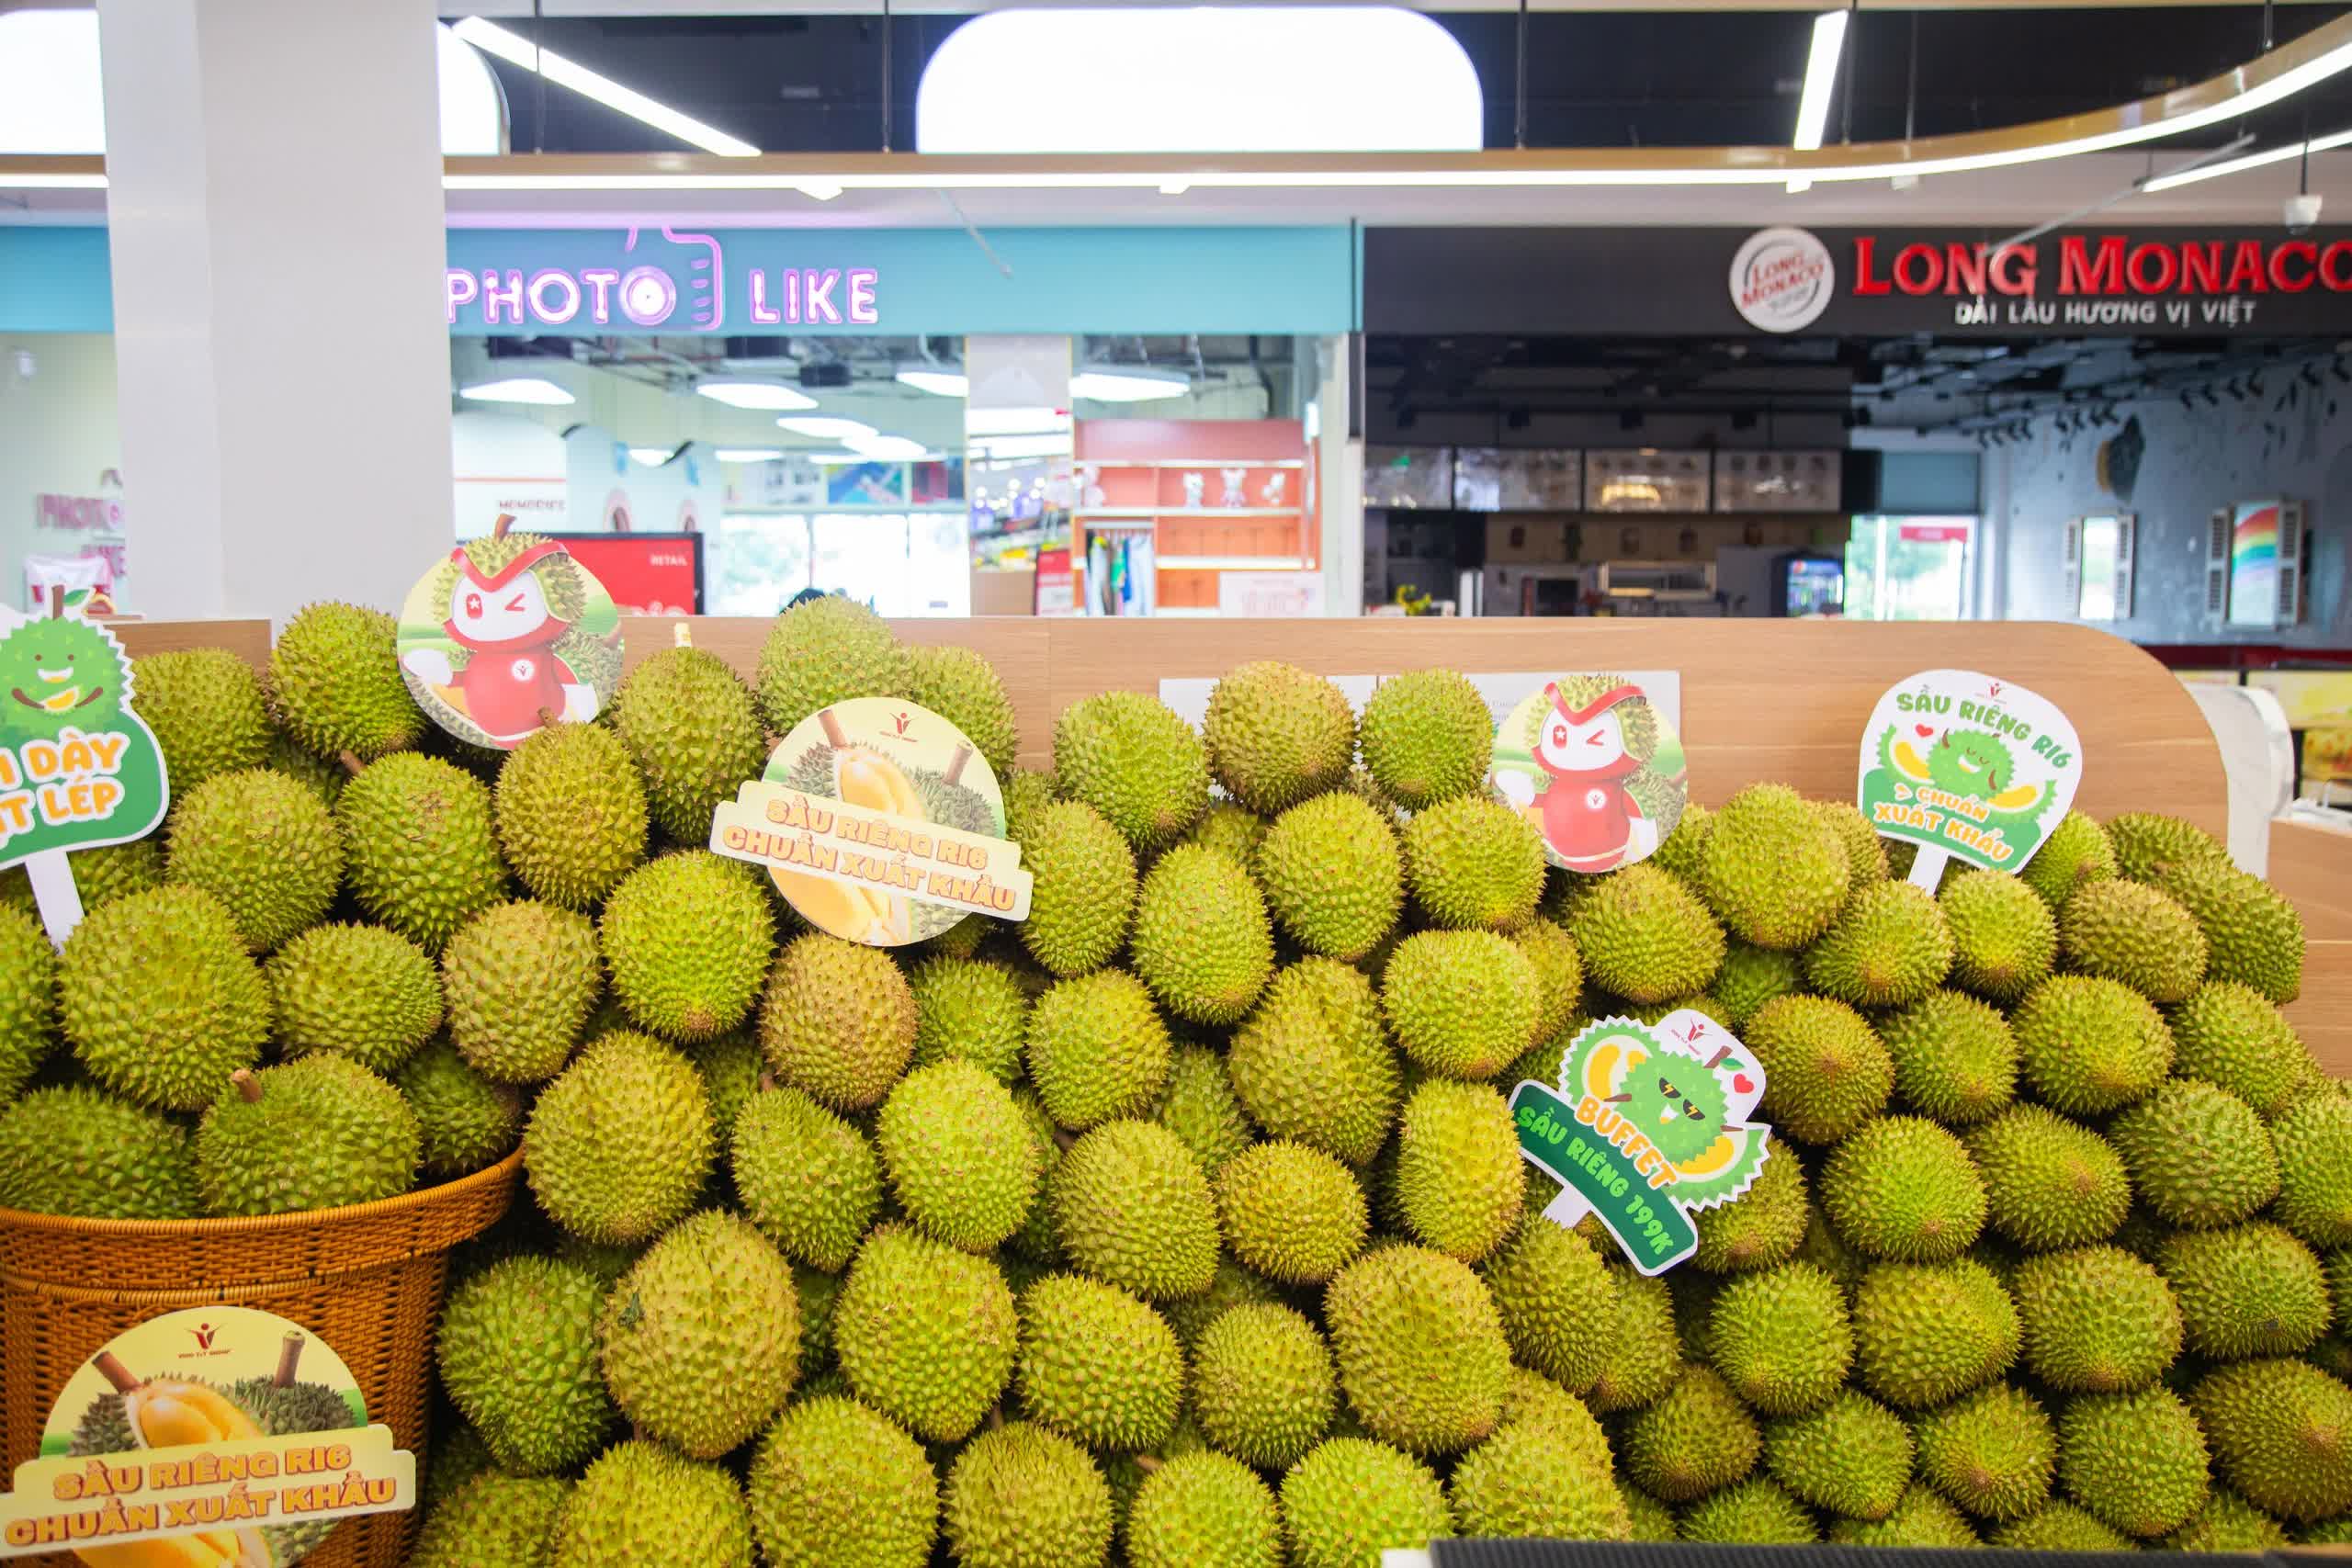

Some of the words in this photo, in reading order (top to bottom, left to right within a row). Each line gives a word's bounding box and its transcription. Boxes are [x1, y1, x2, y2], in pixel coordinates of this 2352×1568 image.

[447, 266, 676, 325] PHOTO
[750, 268, 877, 323] LIKE
[1853, 236, 2038, 297] LONG
[2059, 236, 2352, 294] MONACO
[2165, 300, 2190, 328] VỊ
[2201, 295, 2256, 328] VIỆT
[650, 554, 688, 567] RETAIL
[28, 732, 123, 777] DÀY
[1959, 700, 2031, 740] RIÊNG
[2031, 734, 2073, 769] RI6
[43, 774, 119, 819] LÉP
[836, 816, 933, 859] RIÊNG
[722, 825, 838, 872] CHUẨN
[840, 852, 925, 891] XUẤT
[927, 871, 1016, 911] KHẨU
[1576, 1097, 1677, 1188] BUFFET
[1518, 1106, 1567, 1145] SẦU
[1566, 1137, 1630, 1197] RIÊNG
[1625, 1195, 1674, 1255] 199K
[54, 1460, 141, 1500] SẦU
[149, 1451, 279, 1490] RIÊNG
[286, 1444, 352, 1475] RI6
[5, 1496, 159, 1547] CHUẨN
[166, 1483, 276, 1527] XUẤT
[282, 1471, 396, 1514] KHẨU
